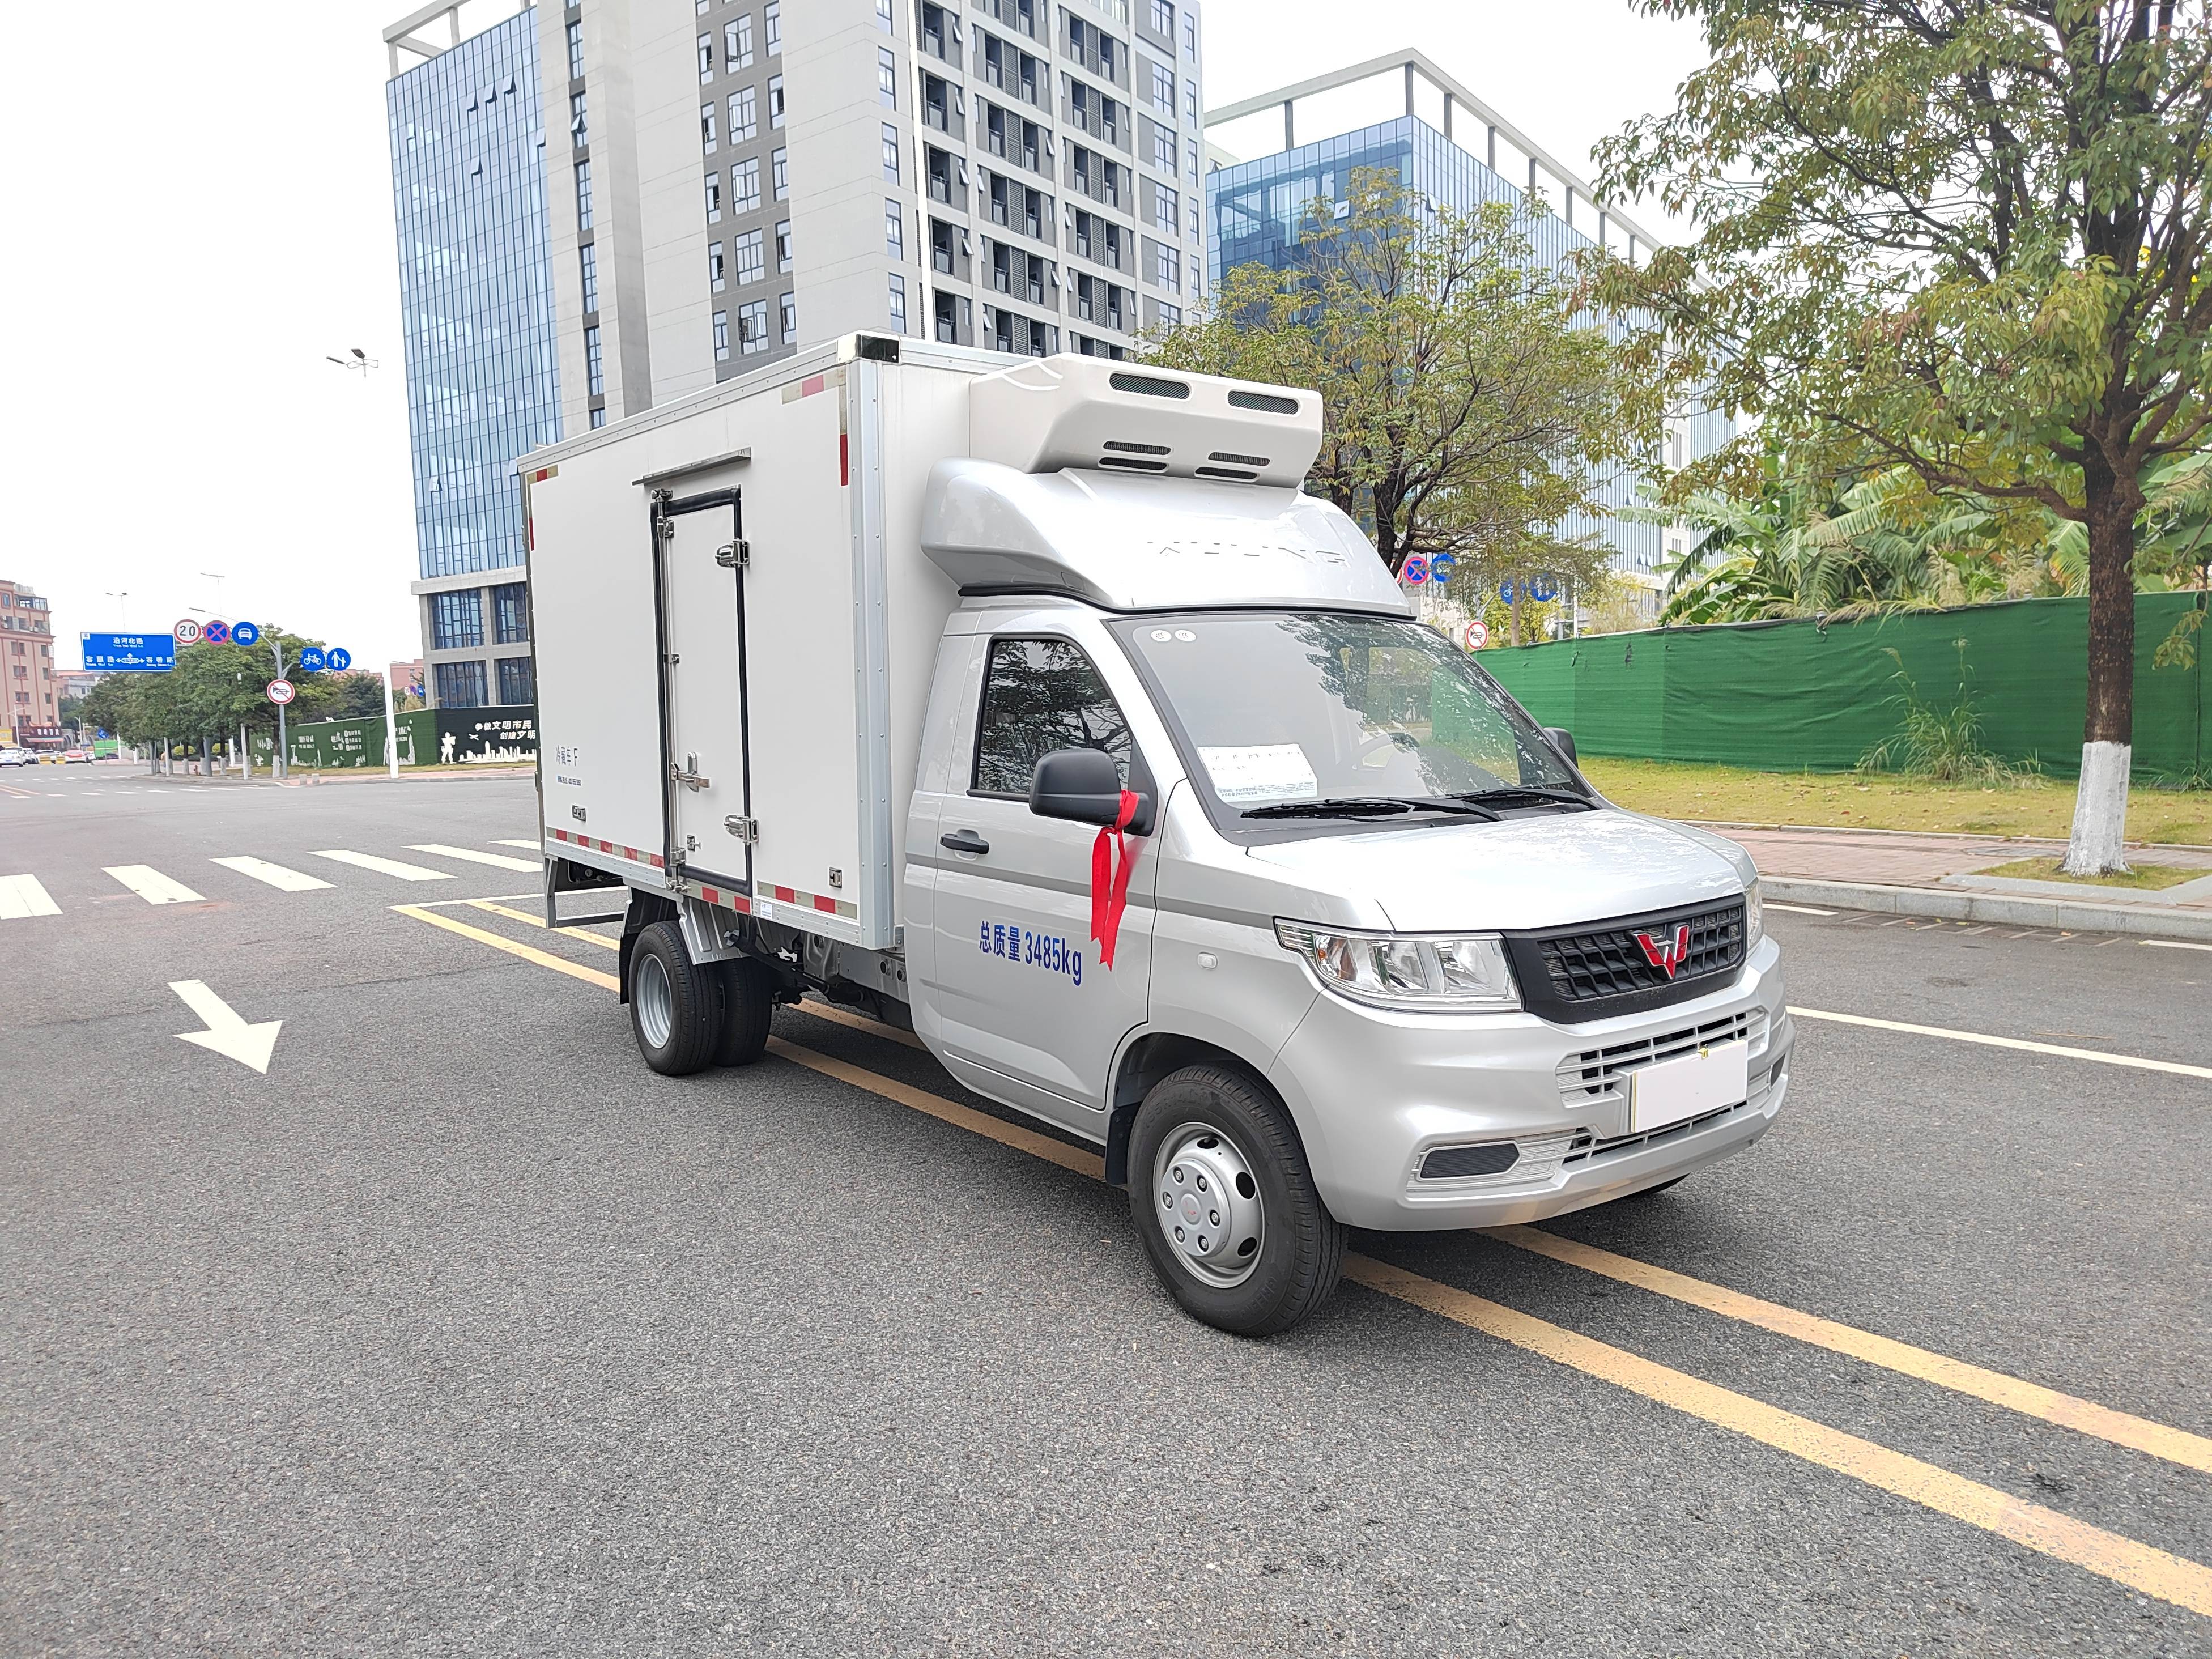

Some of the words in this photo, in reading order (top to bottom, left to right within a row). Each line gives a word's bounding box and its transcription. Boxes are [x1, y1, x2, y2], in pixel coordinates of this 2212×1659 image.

[179, 625, 196, 636] 20
[475, 720, 532, 731] 争做文明市民
[500, 730, 536, 740] 创建文明
[979, 920, 1021, 962] 总质量
[1024, 931, 1082, 986] 3485kg
